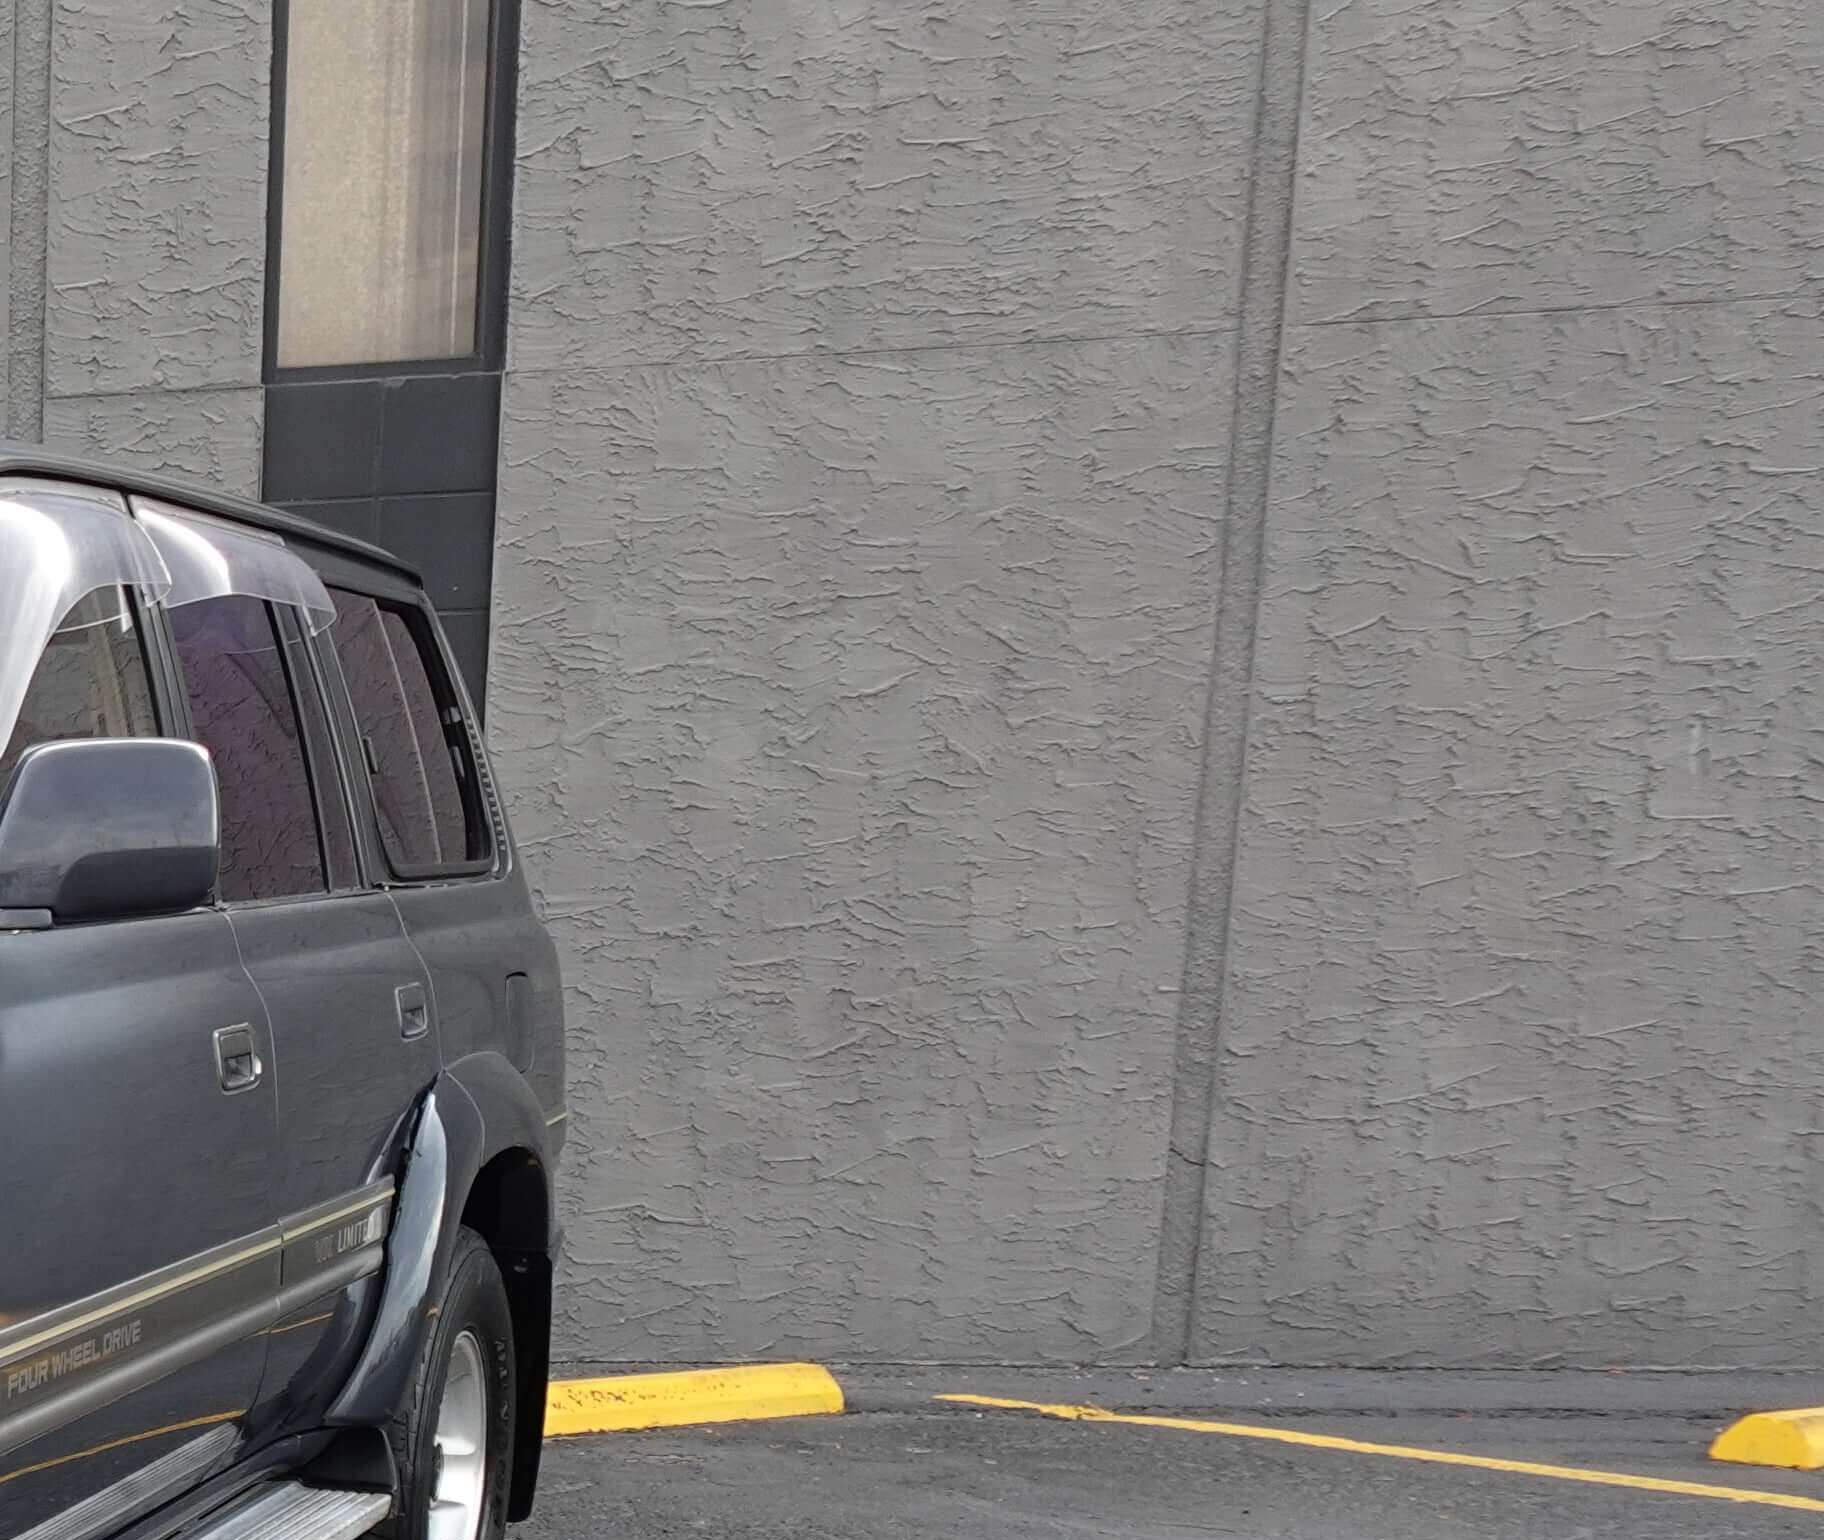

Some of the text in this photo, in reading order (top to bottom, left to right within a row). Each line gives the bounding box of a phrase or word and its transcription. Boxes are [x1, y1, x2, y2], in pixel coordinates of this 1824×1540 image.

[337, 1215, 378, 1253] LIMITE
[7, 1319, 143, 1399] FOUR WHEEL DRIVE
